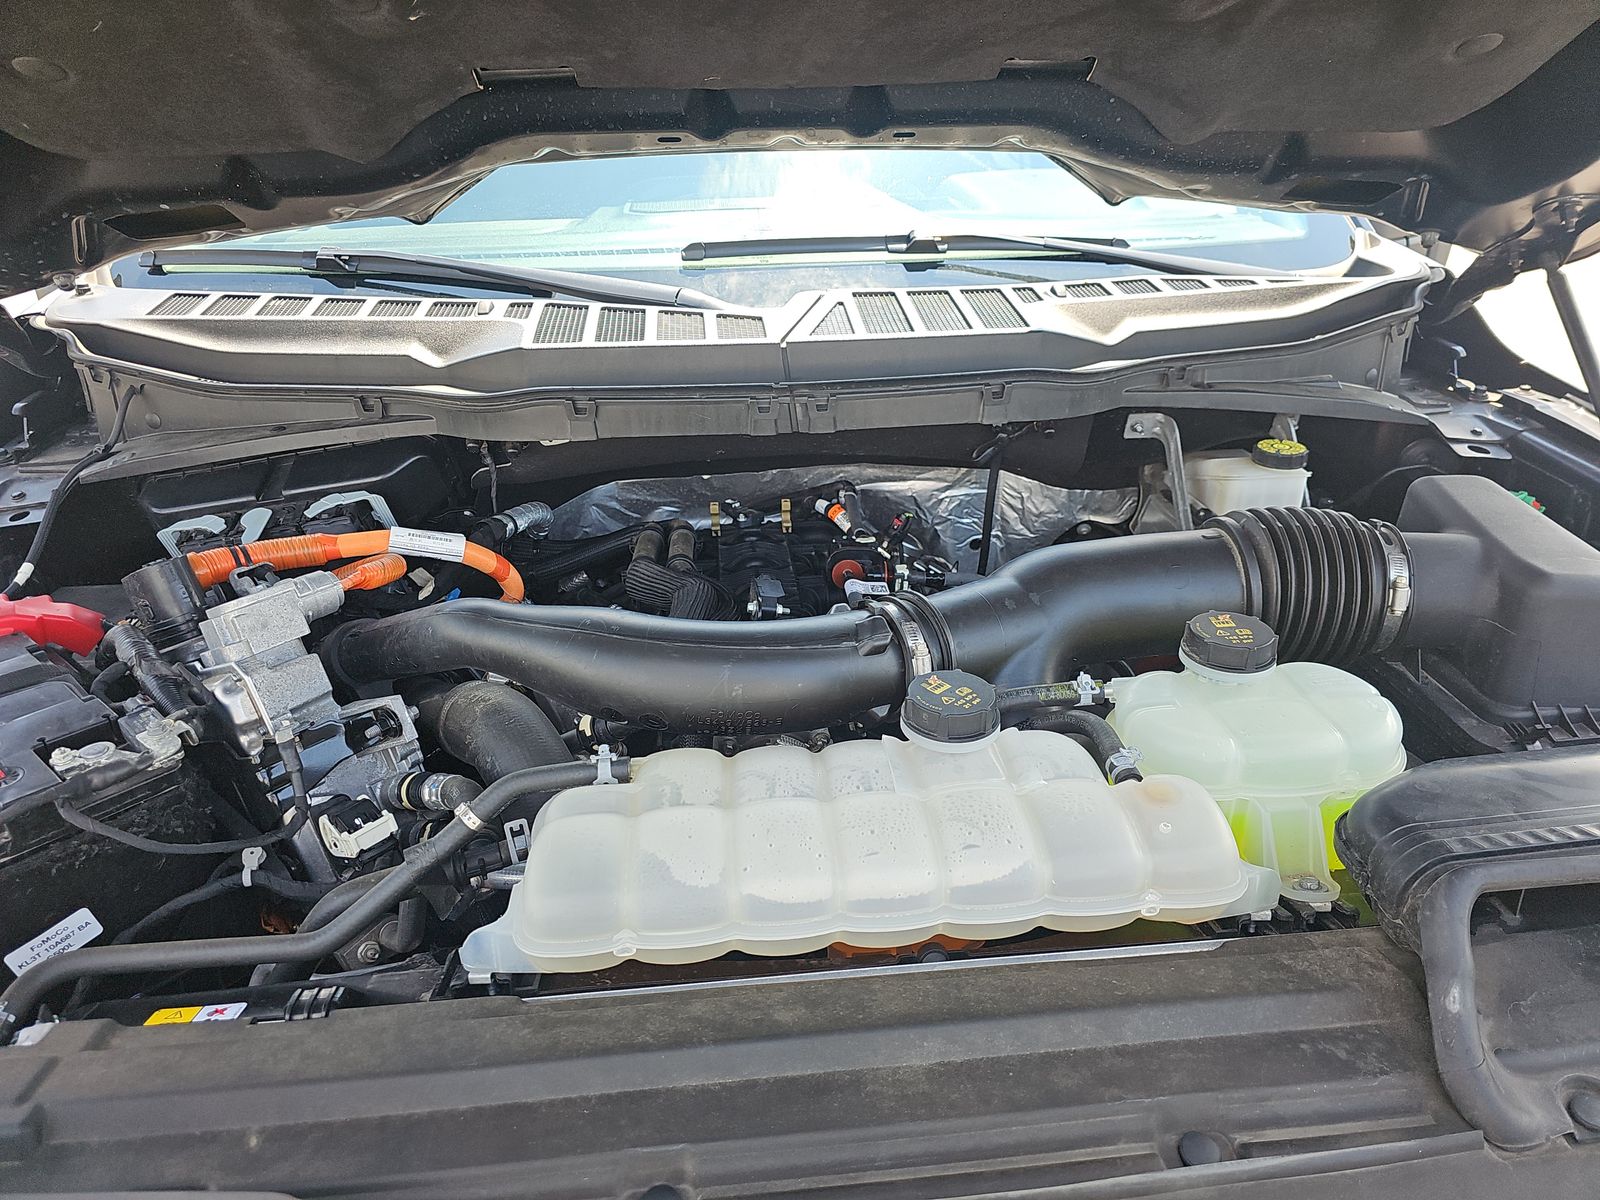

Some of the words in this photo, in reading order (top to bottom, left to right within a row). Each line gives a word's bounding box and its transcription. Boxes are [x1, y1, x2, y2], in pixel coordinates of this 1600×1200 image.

[17, 952, 42, 970] KL3T
[44, 930, 76, 953] 10A687
[77, 920, 93, 932] BA
[29, 925, 70, 952] FoMoCo
